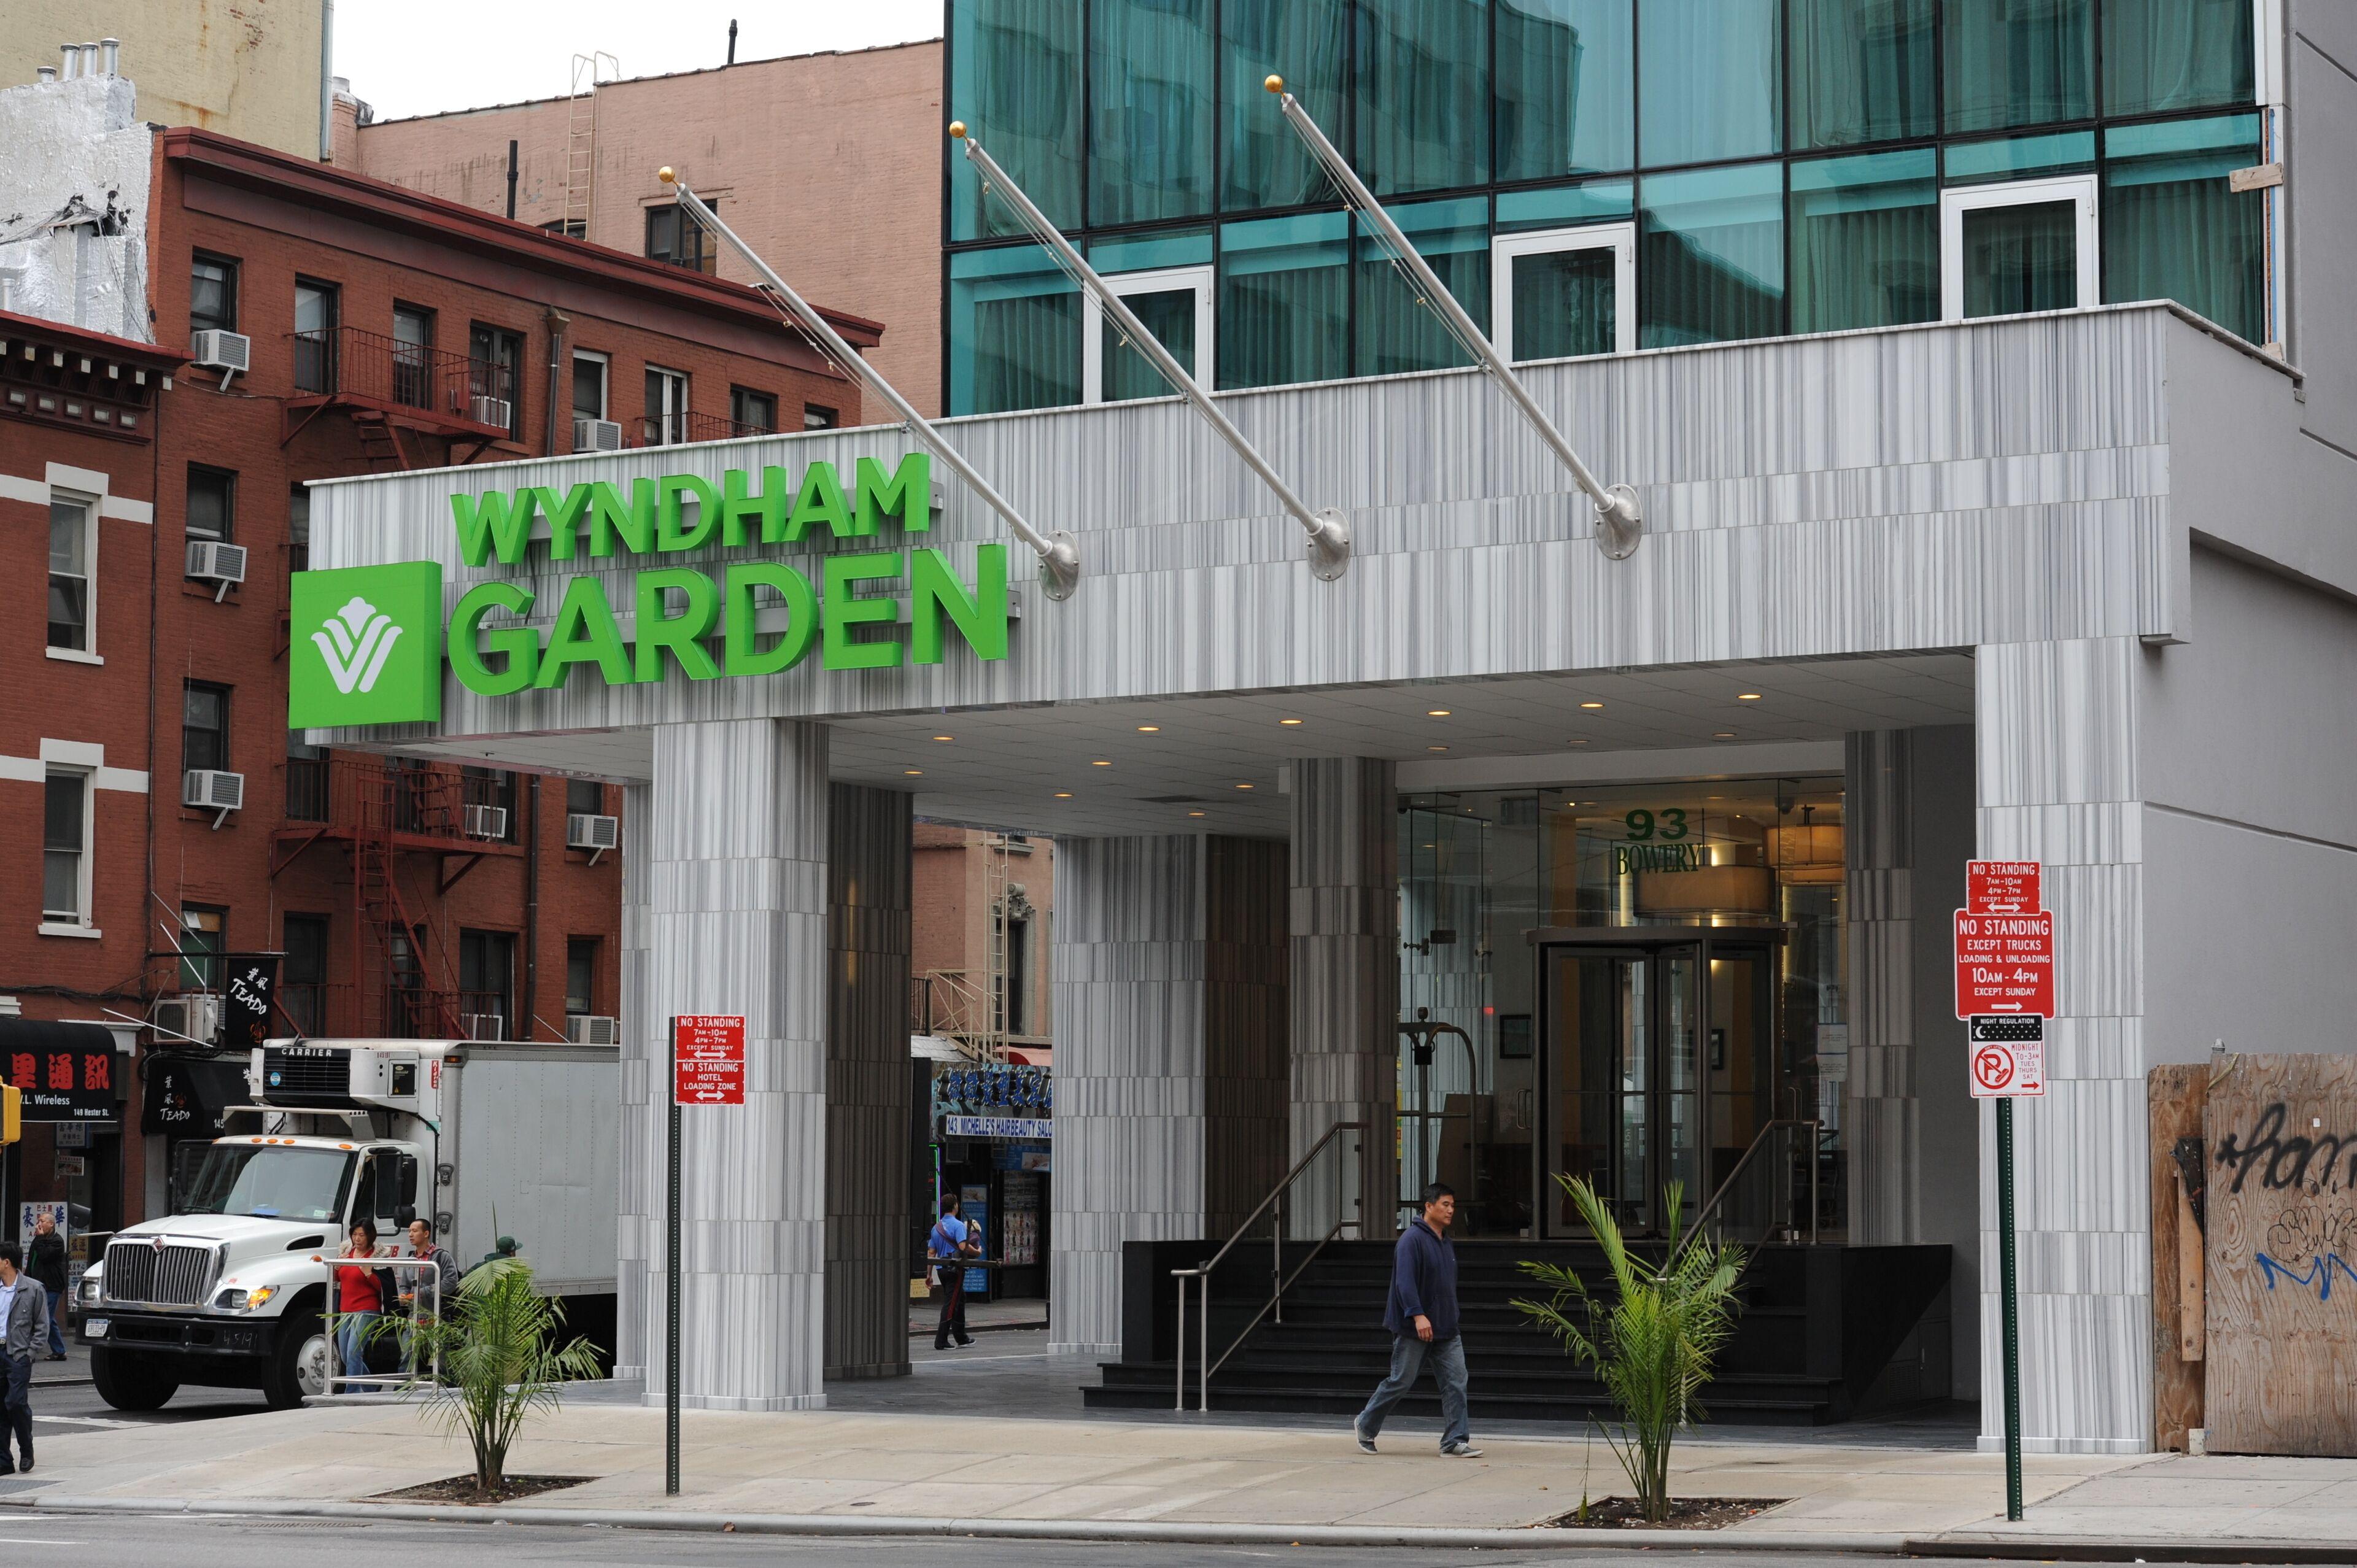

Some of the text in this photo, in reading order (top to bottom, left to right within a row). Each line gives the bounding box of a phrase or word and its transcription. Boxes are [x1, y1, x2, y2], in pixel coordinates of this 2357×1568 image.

[450, 452, 930, 567] WYNDHAM
[447, 544, 1007, 696] GARDEN
[1626, 808, 1688, 841] 93
[1616, 843, 1701, 875] BOWERY
[1973, 865, 2035, 875] NO STANDING
[1959, 919, 2049, 935] NO STANDING
[1967, 940, 2042, 951] EXCEPT TRUCKS
[1972, 967, 2002, 983] 10AM
[2013, 967, 2038, 983] 4PM
[230, 978, 266, 1015] TEADO
[1974, 987, 2036, 996] EXCEPT SUNDAY
[681, 1018, 740, 1027] NO STANDING
[281, 1048, 333, 1057] CARRIER
[683, 1063, 738, 1072] NO STANDING
[34, 1094, 70, 1105] Wireless
[160, 1108, 190, 1121] TEADO
[214, 1119, 225, 1129] 145
[947, 1117, 958, 1134] 143
[961, 1118, 994, 1135] MICHELLE'S
